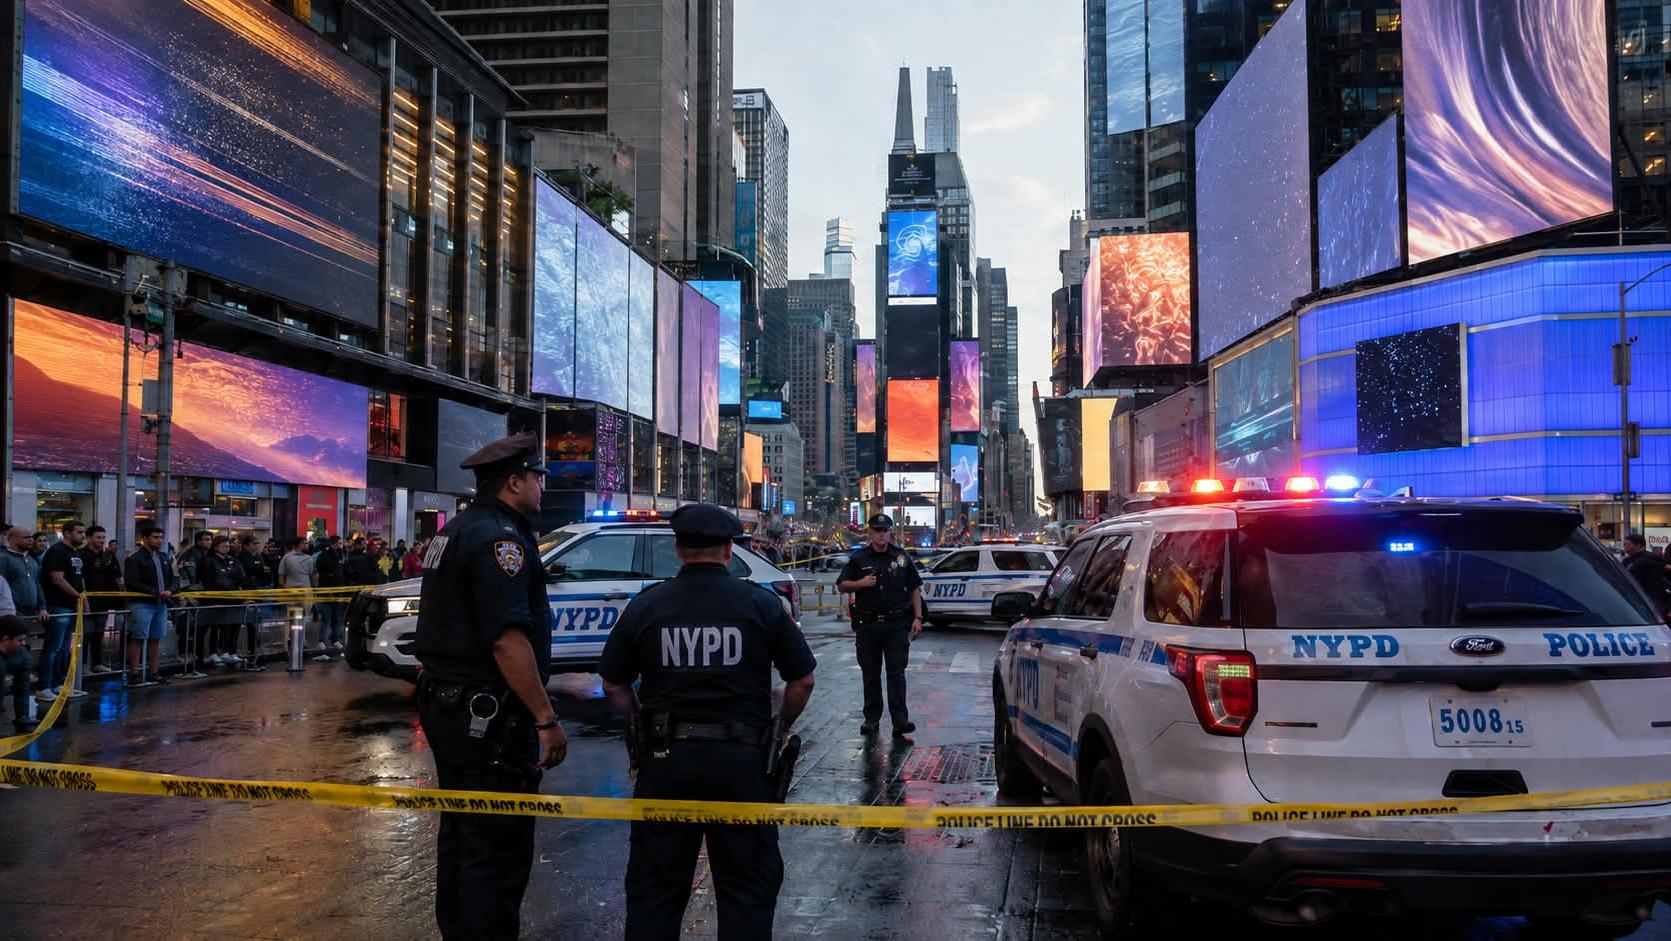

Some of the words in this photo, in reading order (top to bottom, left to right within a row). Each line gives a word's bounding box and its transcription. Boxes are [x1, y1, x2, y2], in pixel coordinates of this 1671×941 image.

[933, 583, 966, 598] NYPD
[661, 626, 743, 667] NYPD
[1291, 634, 1400, 658] NYPD
[1543, 632, 1656, 657] POLICE
[1439, 708, 1503, 734] 5008
[1506, 720, 1524, 734] 15
[60, 770, 97, 792] CROSS
[161, 780, 203, 797] POLICE
